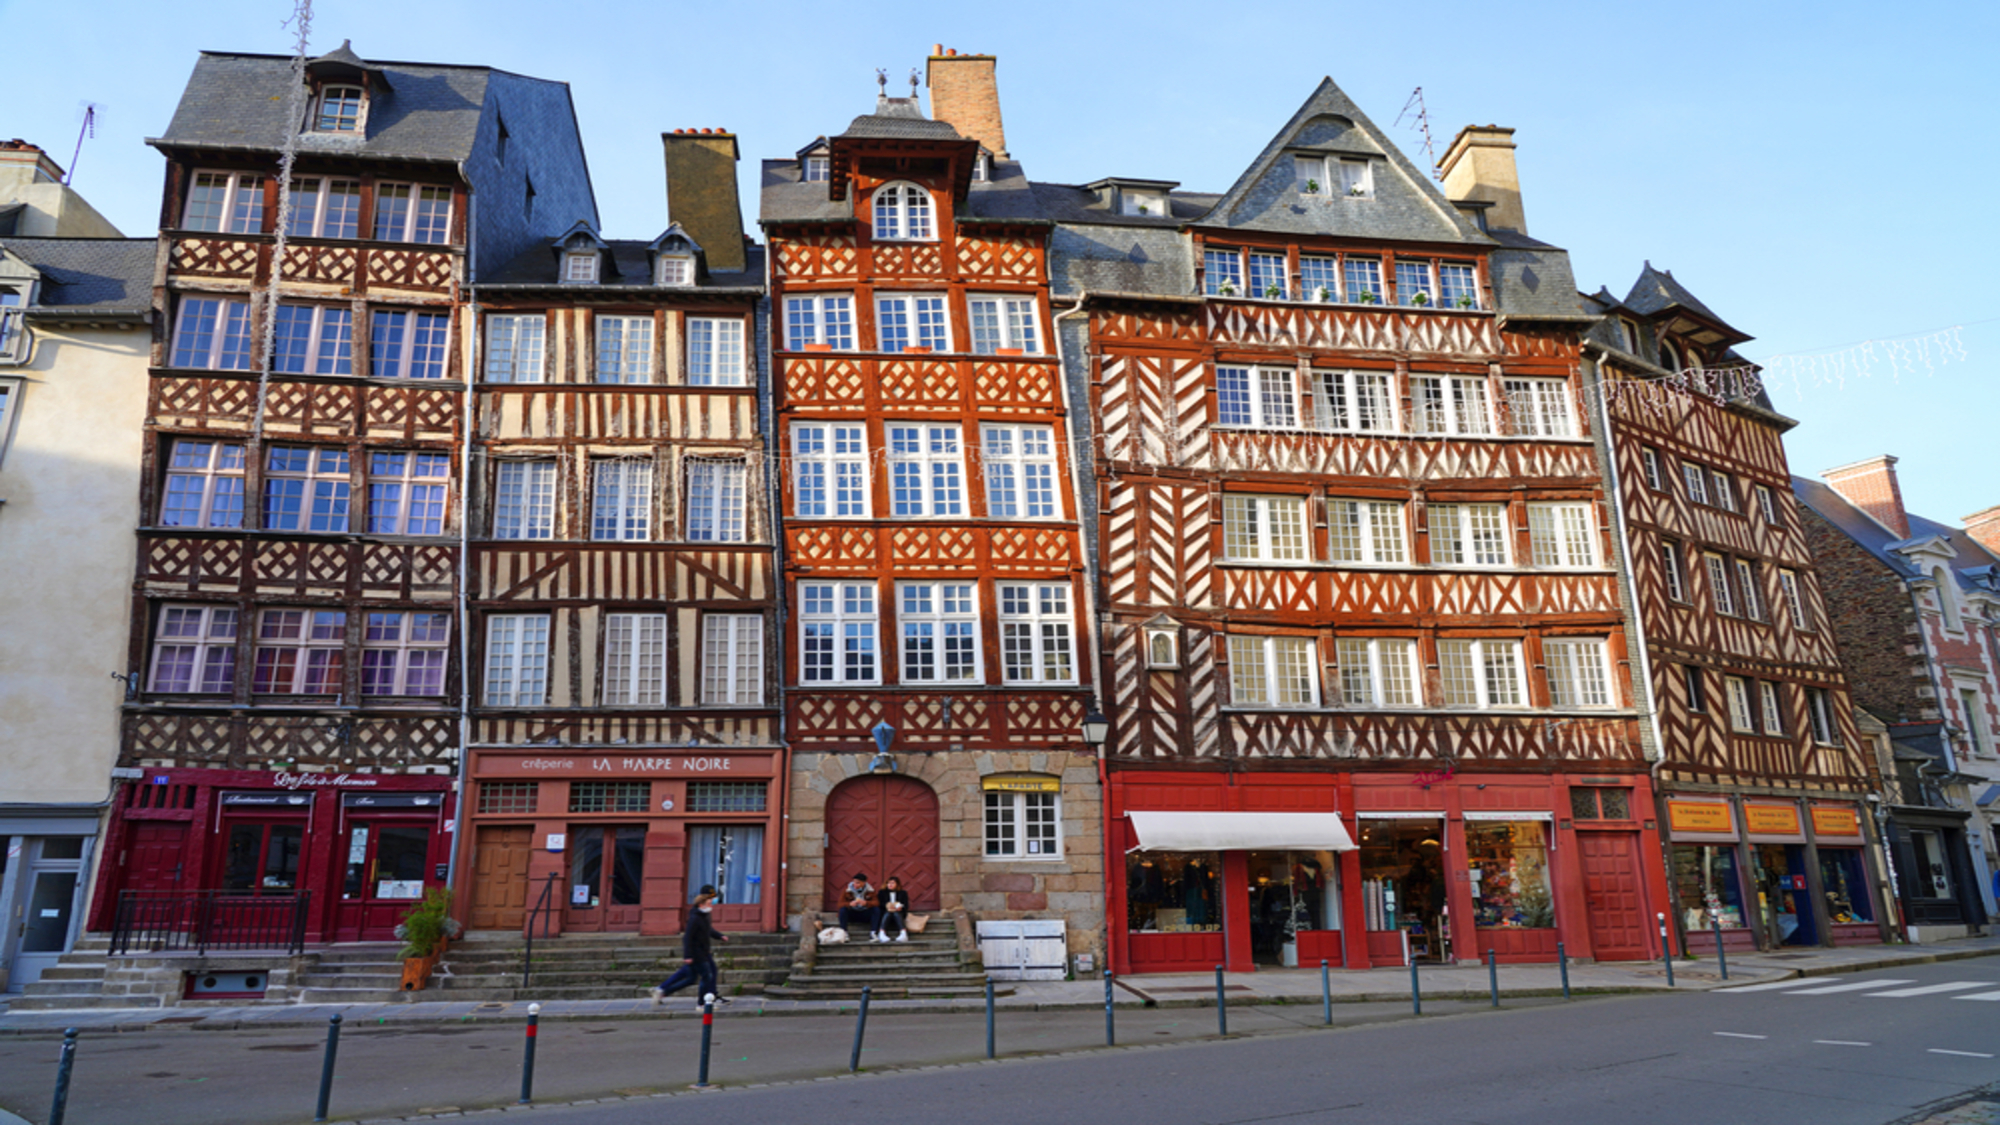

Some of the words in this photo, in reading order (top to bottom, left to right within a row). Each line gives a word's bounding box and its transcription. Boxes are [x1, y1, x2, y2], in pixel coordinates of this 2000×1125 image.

[521, 758, 574, 770] crêperie
[592, 757, 612, 771] LA
[622, 757, 672, 771] HARPE
[682, 757, 730, 771] NOIRE
